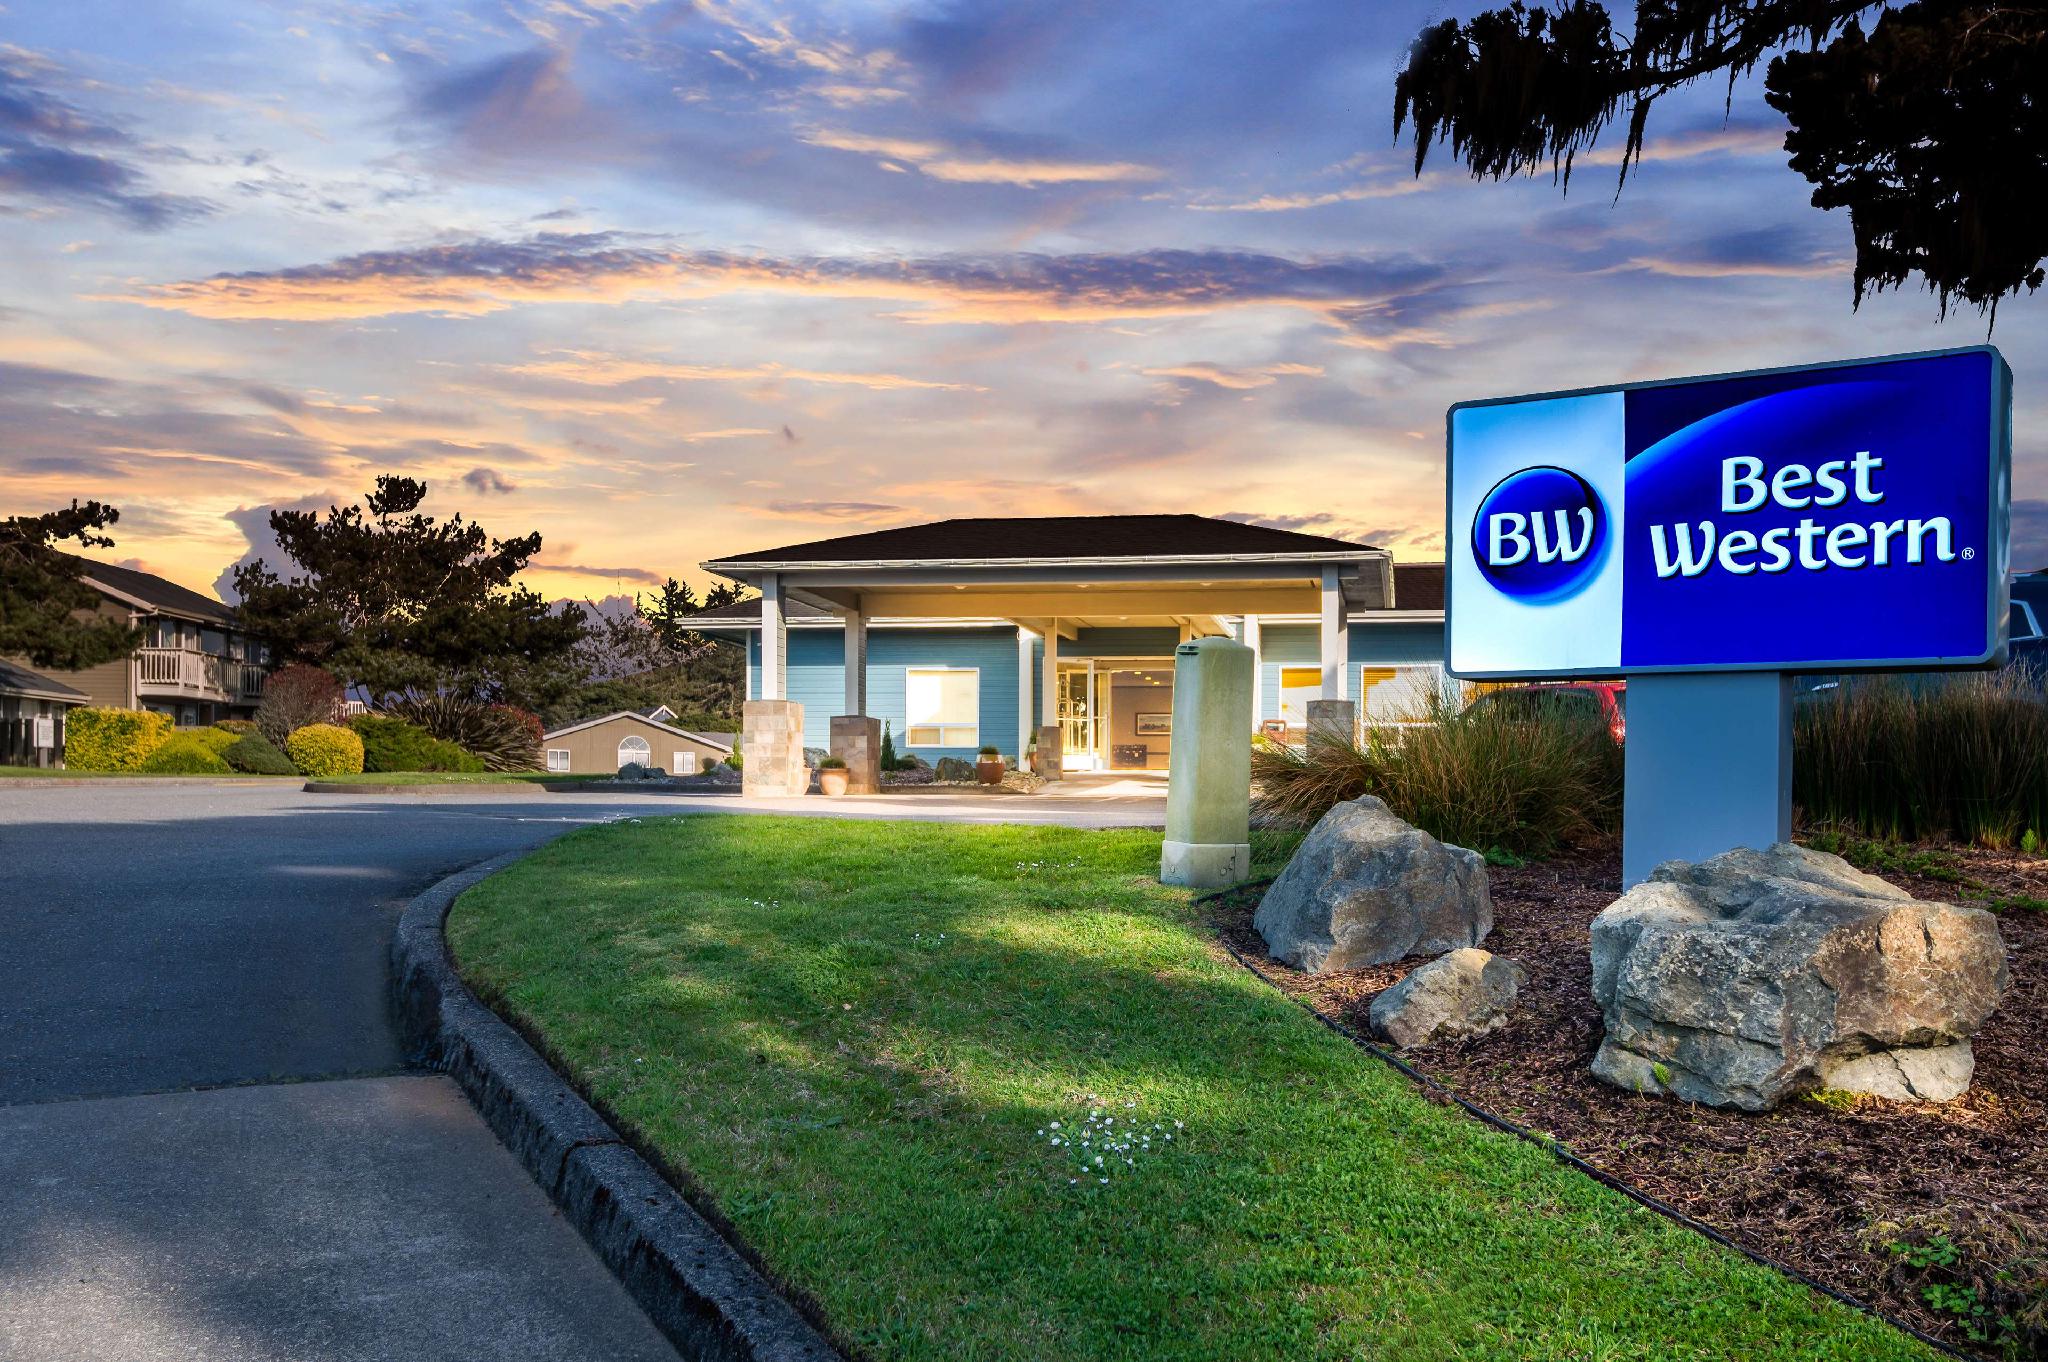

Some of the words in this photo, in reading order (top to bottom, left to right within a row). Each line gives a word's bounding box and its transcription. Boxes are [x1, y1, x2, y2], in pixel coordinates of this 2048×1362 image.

[1721, 450, 1884, 513] Best
[1489, 506, 1594, 566] BW
[1650, 516, 1956, 578] Western
